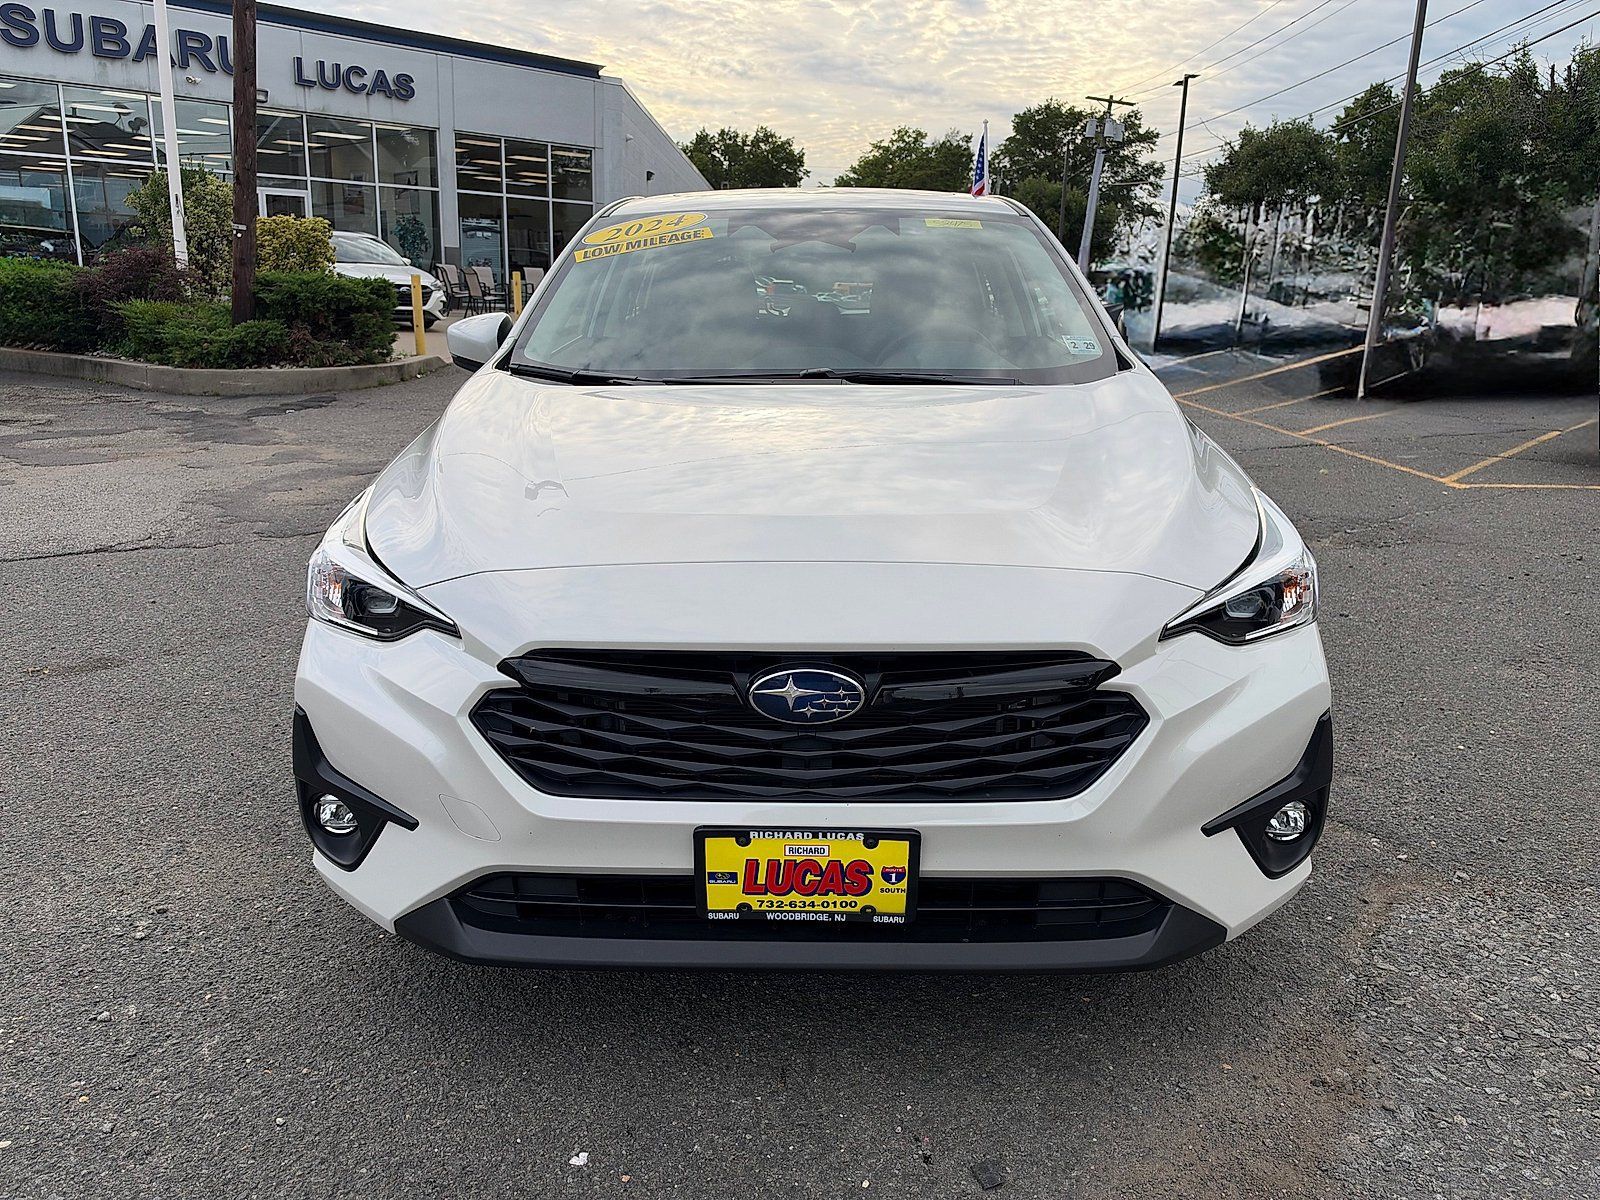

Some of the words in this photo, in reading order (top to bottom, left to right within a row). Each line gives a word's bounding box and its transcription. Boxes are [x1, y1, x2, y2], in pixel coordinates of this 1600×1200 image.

[293, 56, 416, 101] LUCAS
[603, 215, 685, 241] 2024
[582, 243, 625, 260] LOW
[749, 831, 813, 841] RICHARD
[818, 832, 865, 841] LUCAS
[788, 846, 826, 855] RICHARD
[742, 858, 875, 897] LUCAS
[889, 872, 898, 883] 1
[756, 899, 859, 909] 732-634-0100
[707, 912, 740, 920] SUBARU
[834, 913, 847, 922] NJ
[872, 915, 905, 924] SUBARU
